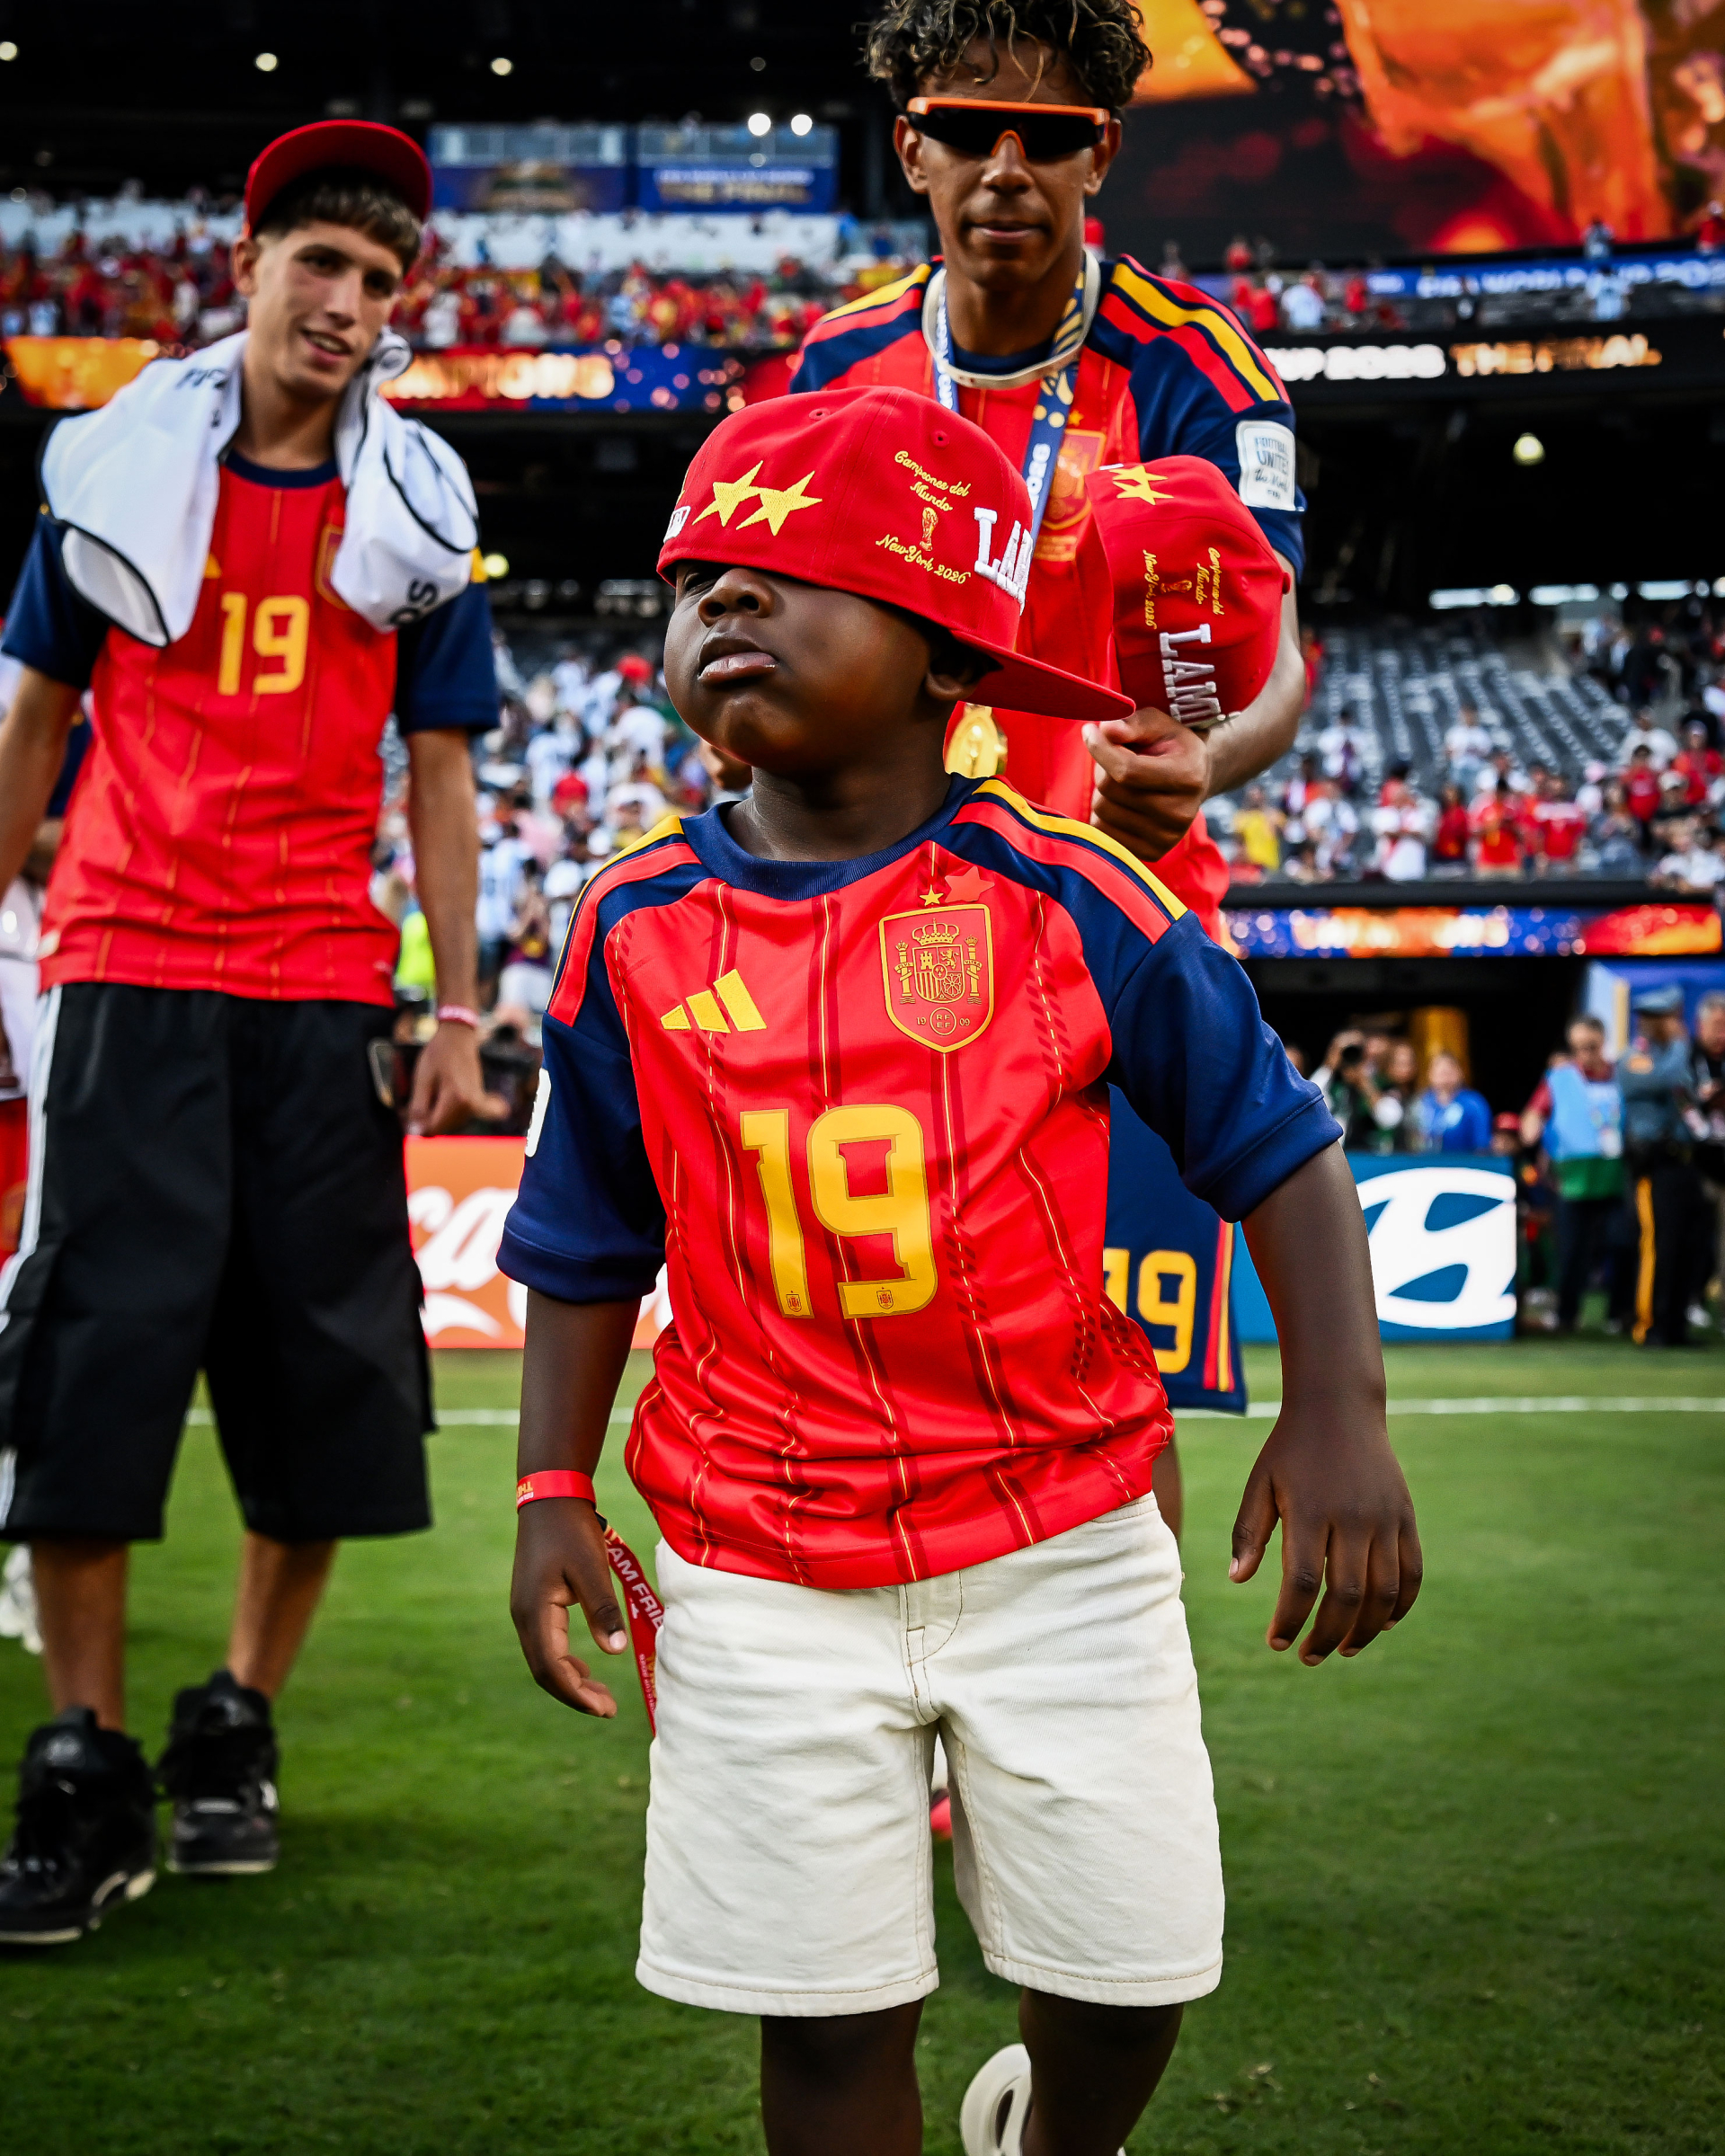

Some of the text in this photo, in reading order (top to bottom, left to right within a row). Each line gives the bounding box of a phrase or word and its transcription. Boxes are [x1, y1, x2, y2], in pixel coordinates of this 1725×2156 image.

[1263, 347, 1325, 381] UP
[894, 450, 971, 497] Campeones del
[910, 481, 953, 511] Mundo
[933, 564, 971, 584] 2026
[218, 590, 310, 696] 19
[917, 1016, 927, 1025] 19
[959, 1017, 971, 1026] 09
[740, 1103, 938, 1319] 19
[1103, 1247, 1197, 1374] 19
[608, 1547, 639, 1582] AM
[632, 1582, 664, 1629] FRIE
